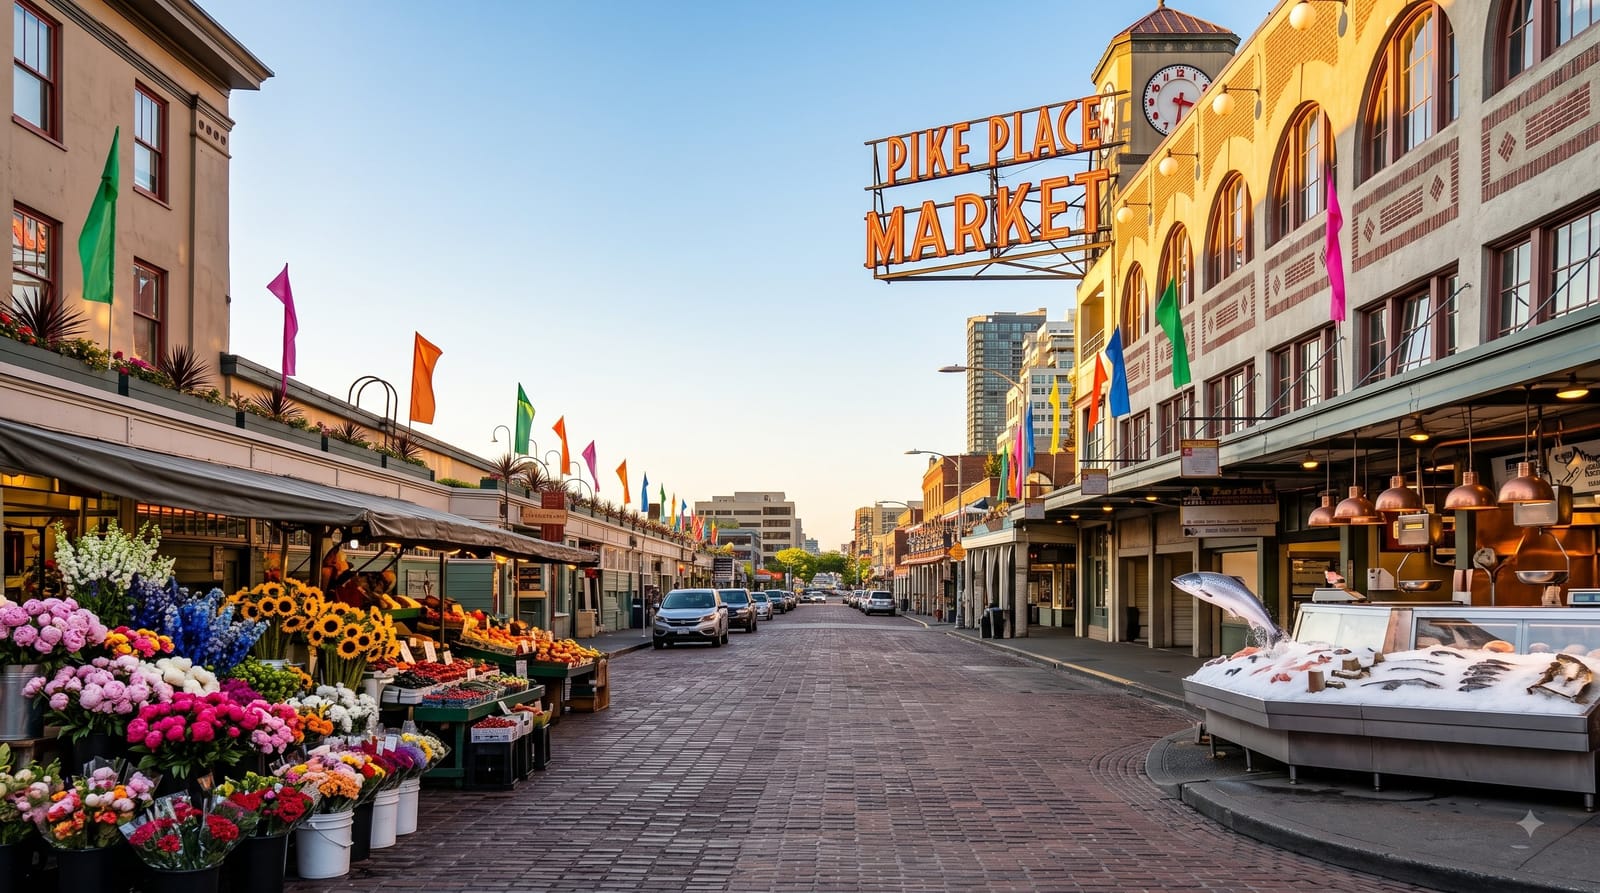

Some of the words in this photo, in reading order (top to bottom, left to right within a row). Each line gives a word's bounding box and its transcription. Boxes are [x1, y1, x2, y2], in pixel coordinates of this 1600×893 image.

[1176, 69, 1184, 77] 12
[1152, 84, 1160, 92] 10
[1148, 98, 1154, 106] 9
[1163, 122, 1168, 130] 7
[887, 122, 970, 186] PIKE
[989, 95, 1101, 167] PLACE
[866, 168, 1110, 268] MARKET
